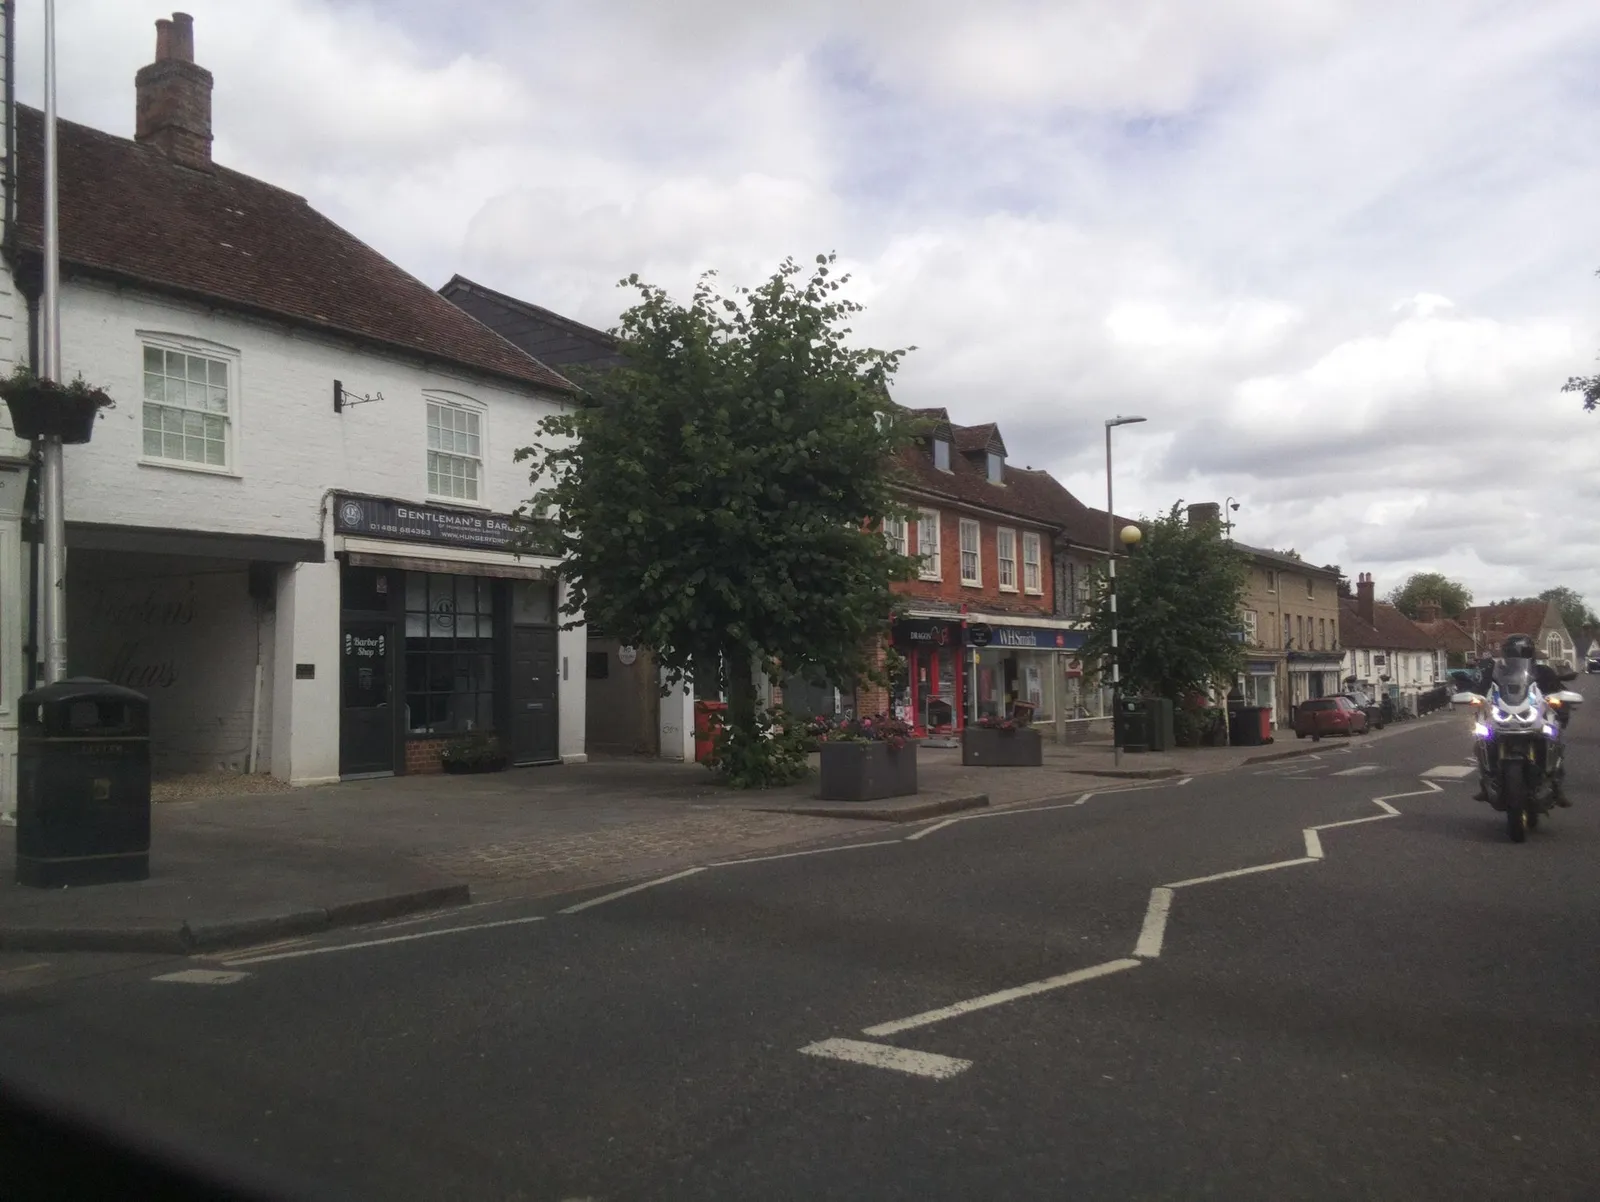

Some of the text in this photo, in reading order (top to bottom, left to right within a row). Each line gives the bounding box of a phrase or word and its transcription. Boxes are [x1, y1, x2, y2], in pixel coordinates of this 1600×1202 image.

[397, 508, 535, 535] GENTLEMAN'S BARER
[370, 523, 397, 532] 01488
[353, 637, 379, 647] Barber
[999, 628, 1037, 647] WHSmith
[357, 647, 375, 658] Shop
